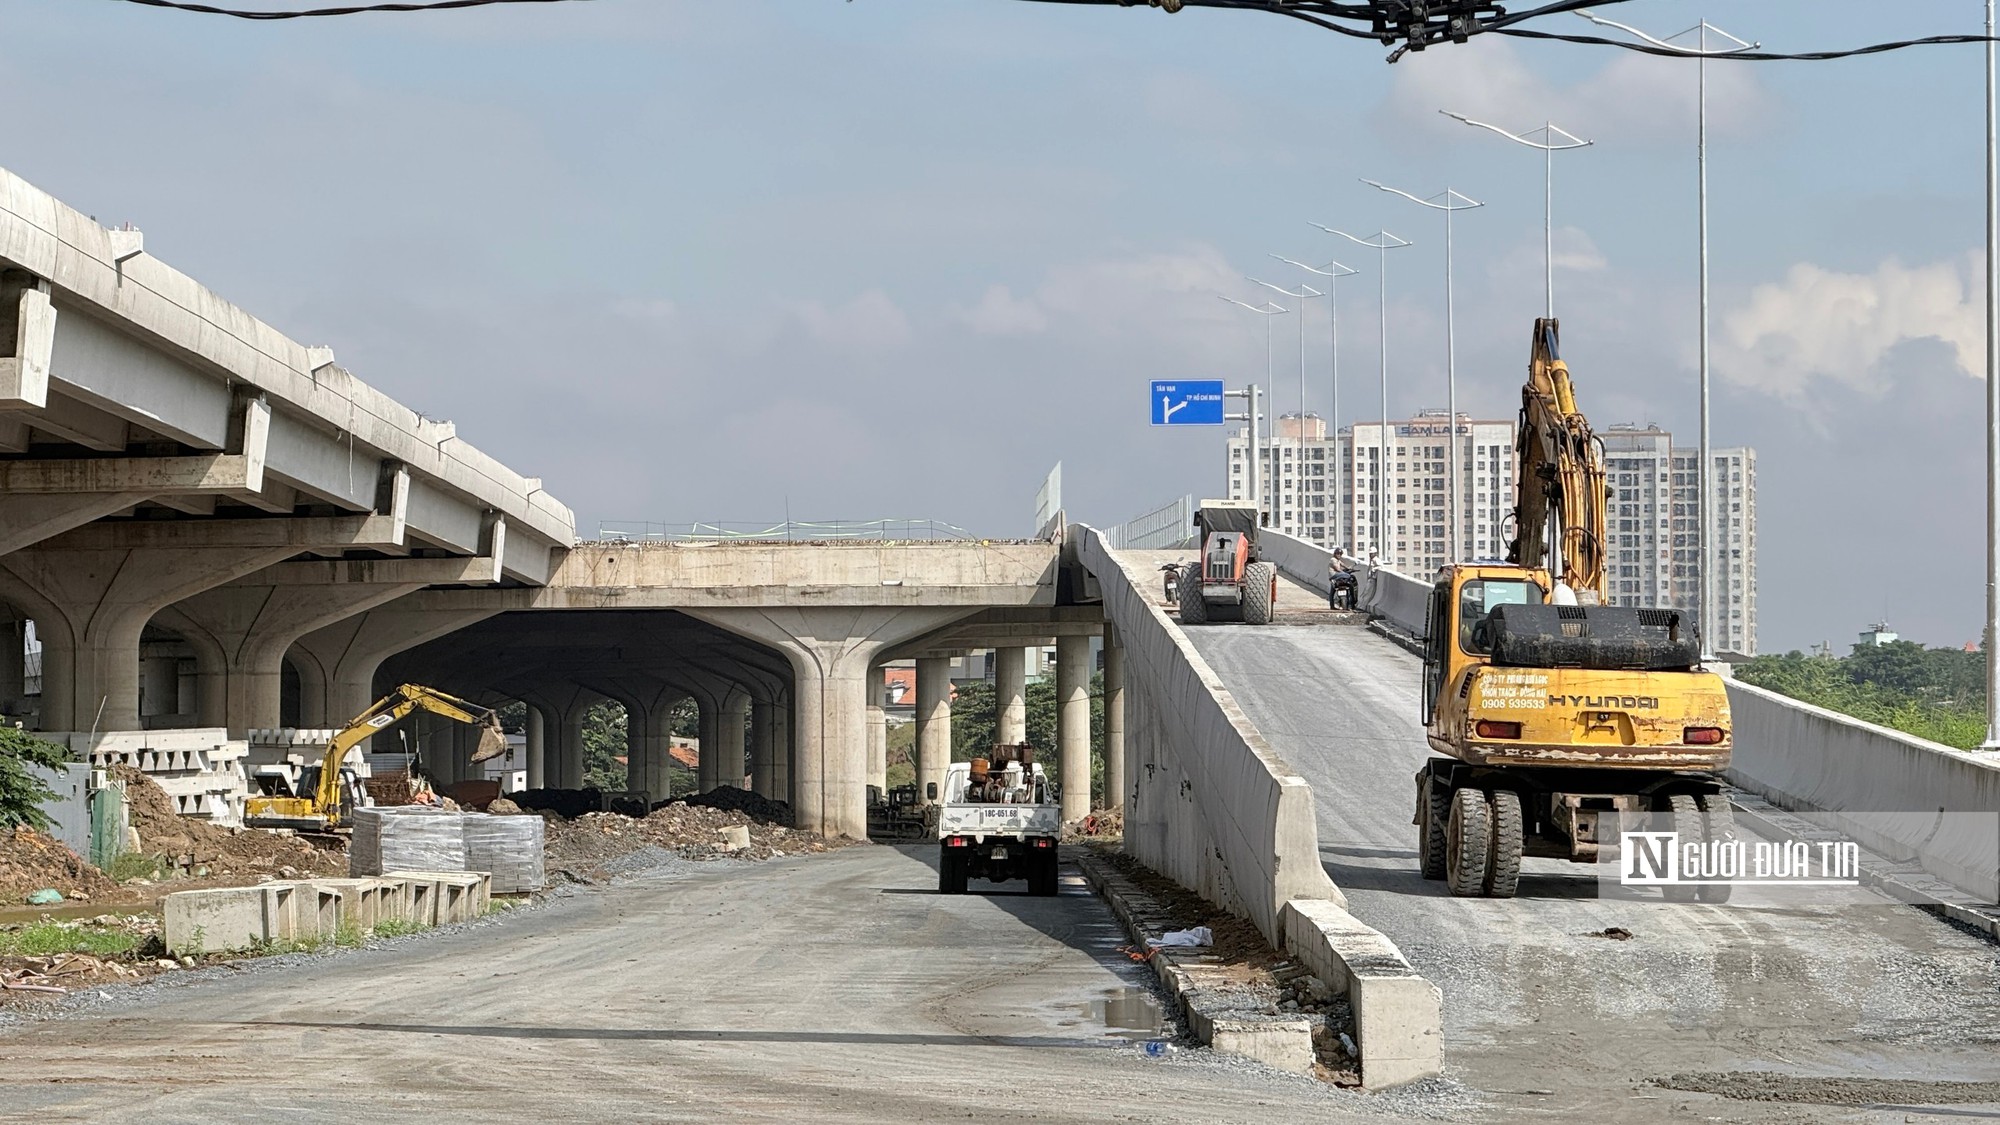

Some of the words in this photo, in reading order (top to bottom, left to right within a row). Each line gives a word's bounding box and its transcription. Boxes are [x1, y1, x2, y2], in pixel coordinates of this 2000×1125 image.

[1482, 698, 1506, 709] 0908
[1509, 699, 1545, 709] 939533
[1549, 695, 1658, 709] HYUNDAI
